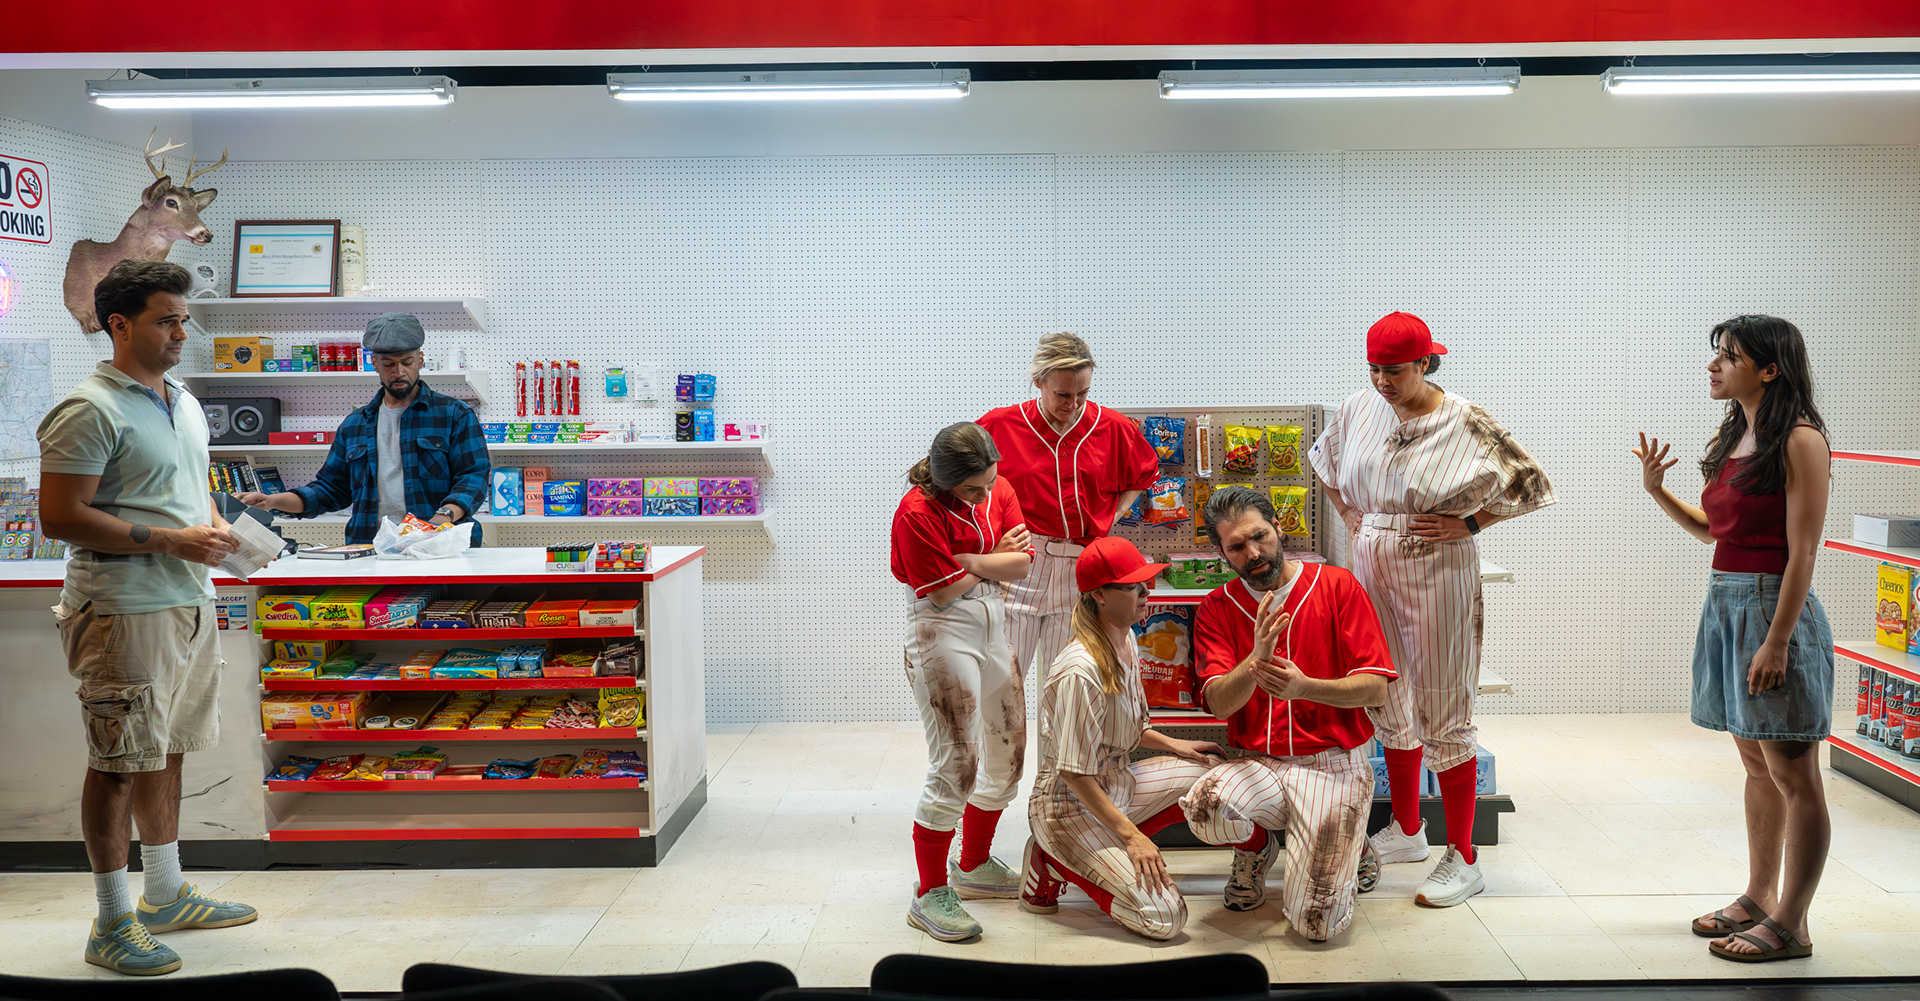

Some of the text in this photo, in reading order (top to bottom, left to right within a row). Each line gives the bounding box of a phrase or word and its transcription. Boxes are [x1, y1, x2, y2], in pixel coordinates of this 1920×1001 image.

[0, 161, 12, 200] O
[0, 210, 44, 237] OKING
[1153, 428, 1178, 438] Doritos
[1270, 432, 1297, 444] FUNYUNS
[1880, 577, 1904, 594] Cheerios
[538, 613, 566, 622] Reese's
[1139, 664, 1174, 676] CHEDDAR
